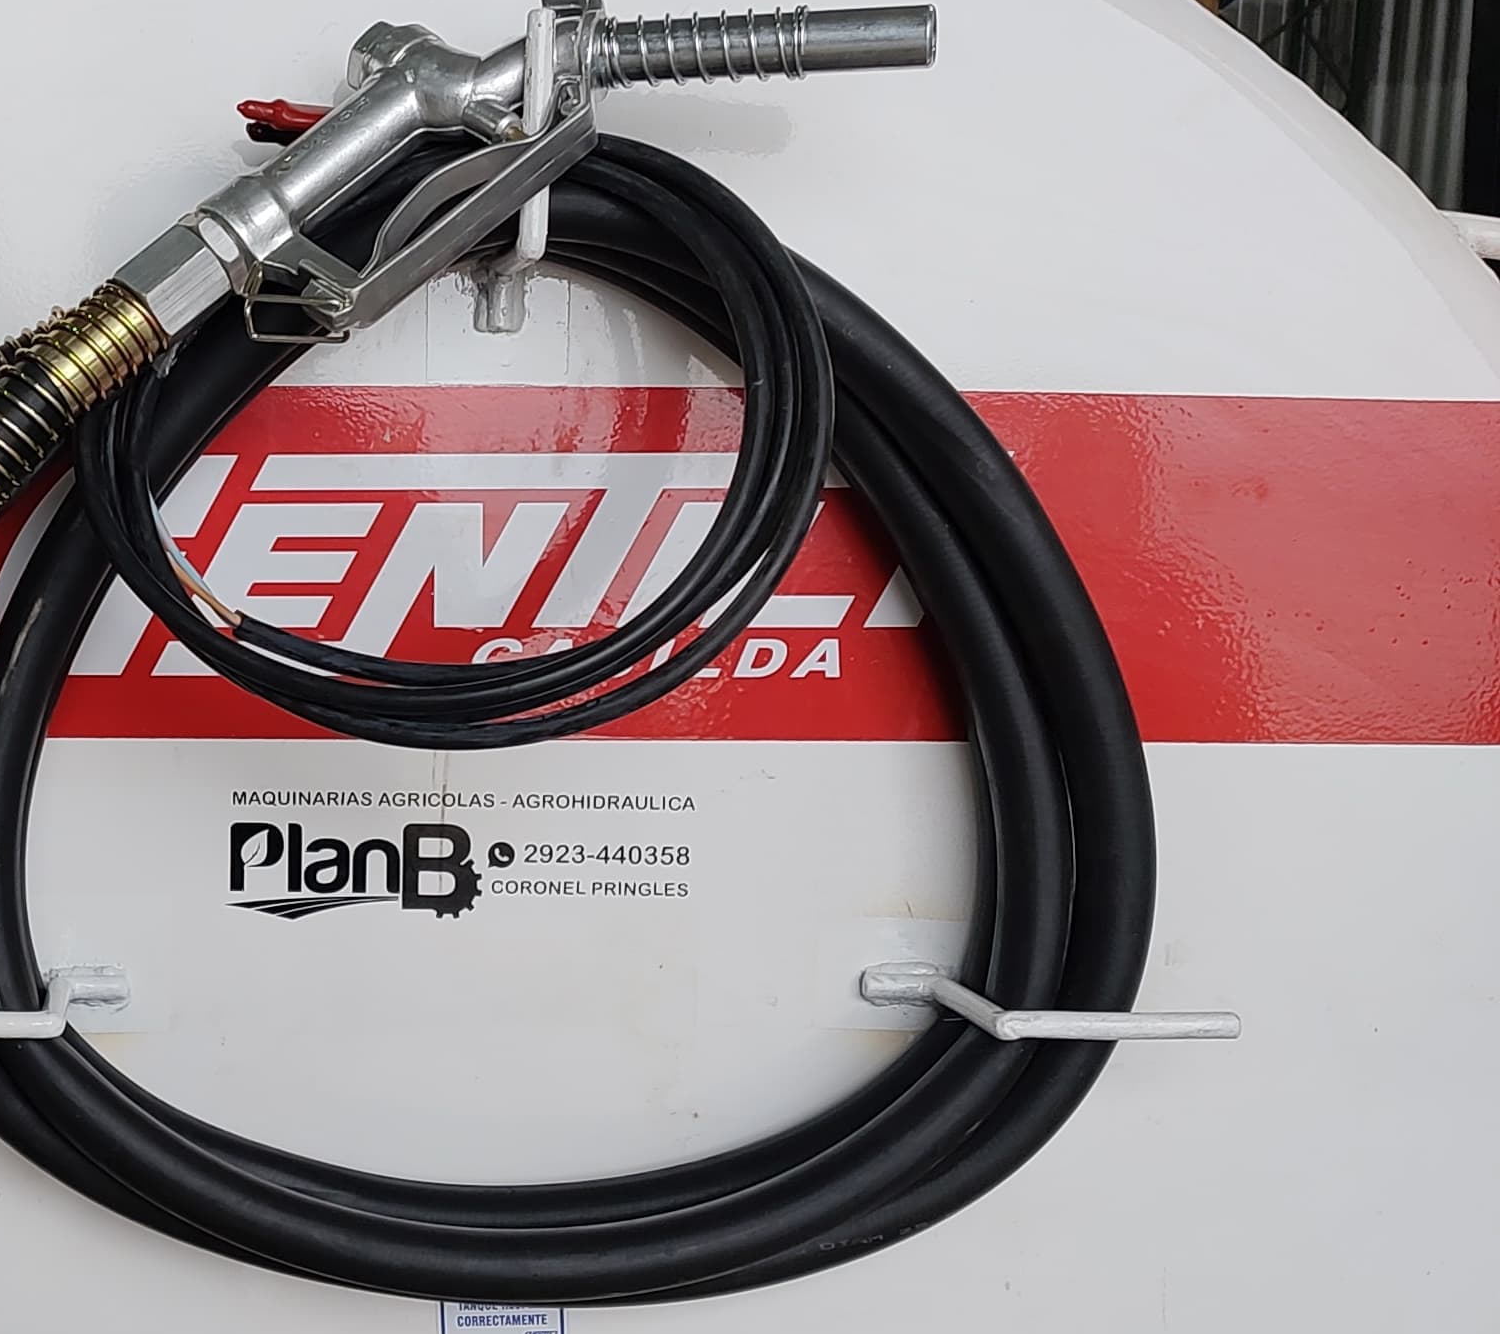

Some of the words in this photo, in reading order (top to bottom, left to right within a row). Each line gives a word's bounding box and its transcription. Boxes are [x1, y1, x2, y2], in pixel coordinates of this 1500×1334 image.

[233, 791, 372, 806] MAQUINARIAS
[378, 792, 495, 808] AGRICOLAS
[513, 795, 694, 810] AGROHIDRAULICA
[525, 845, 689, 865] 2923-440358
[492, 881, 584, 894] CORONEL
[593, 883, 687, 896] PRINGLES
[457, 1314, 547, 1327] CORRECTAMENTE
